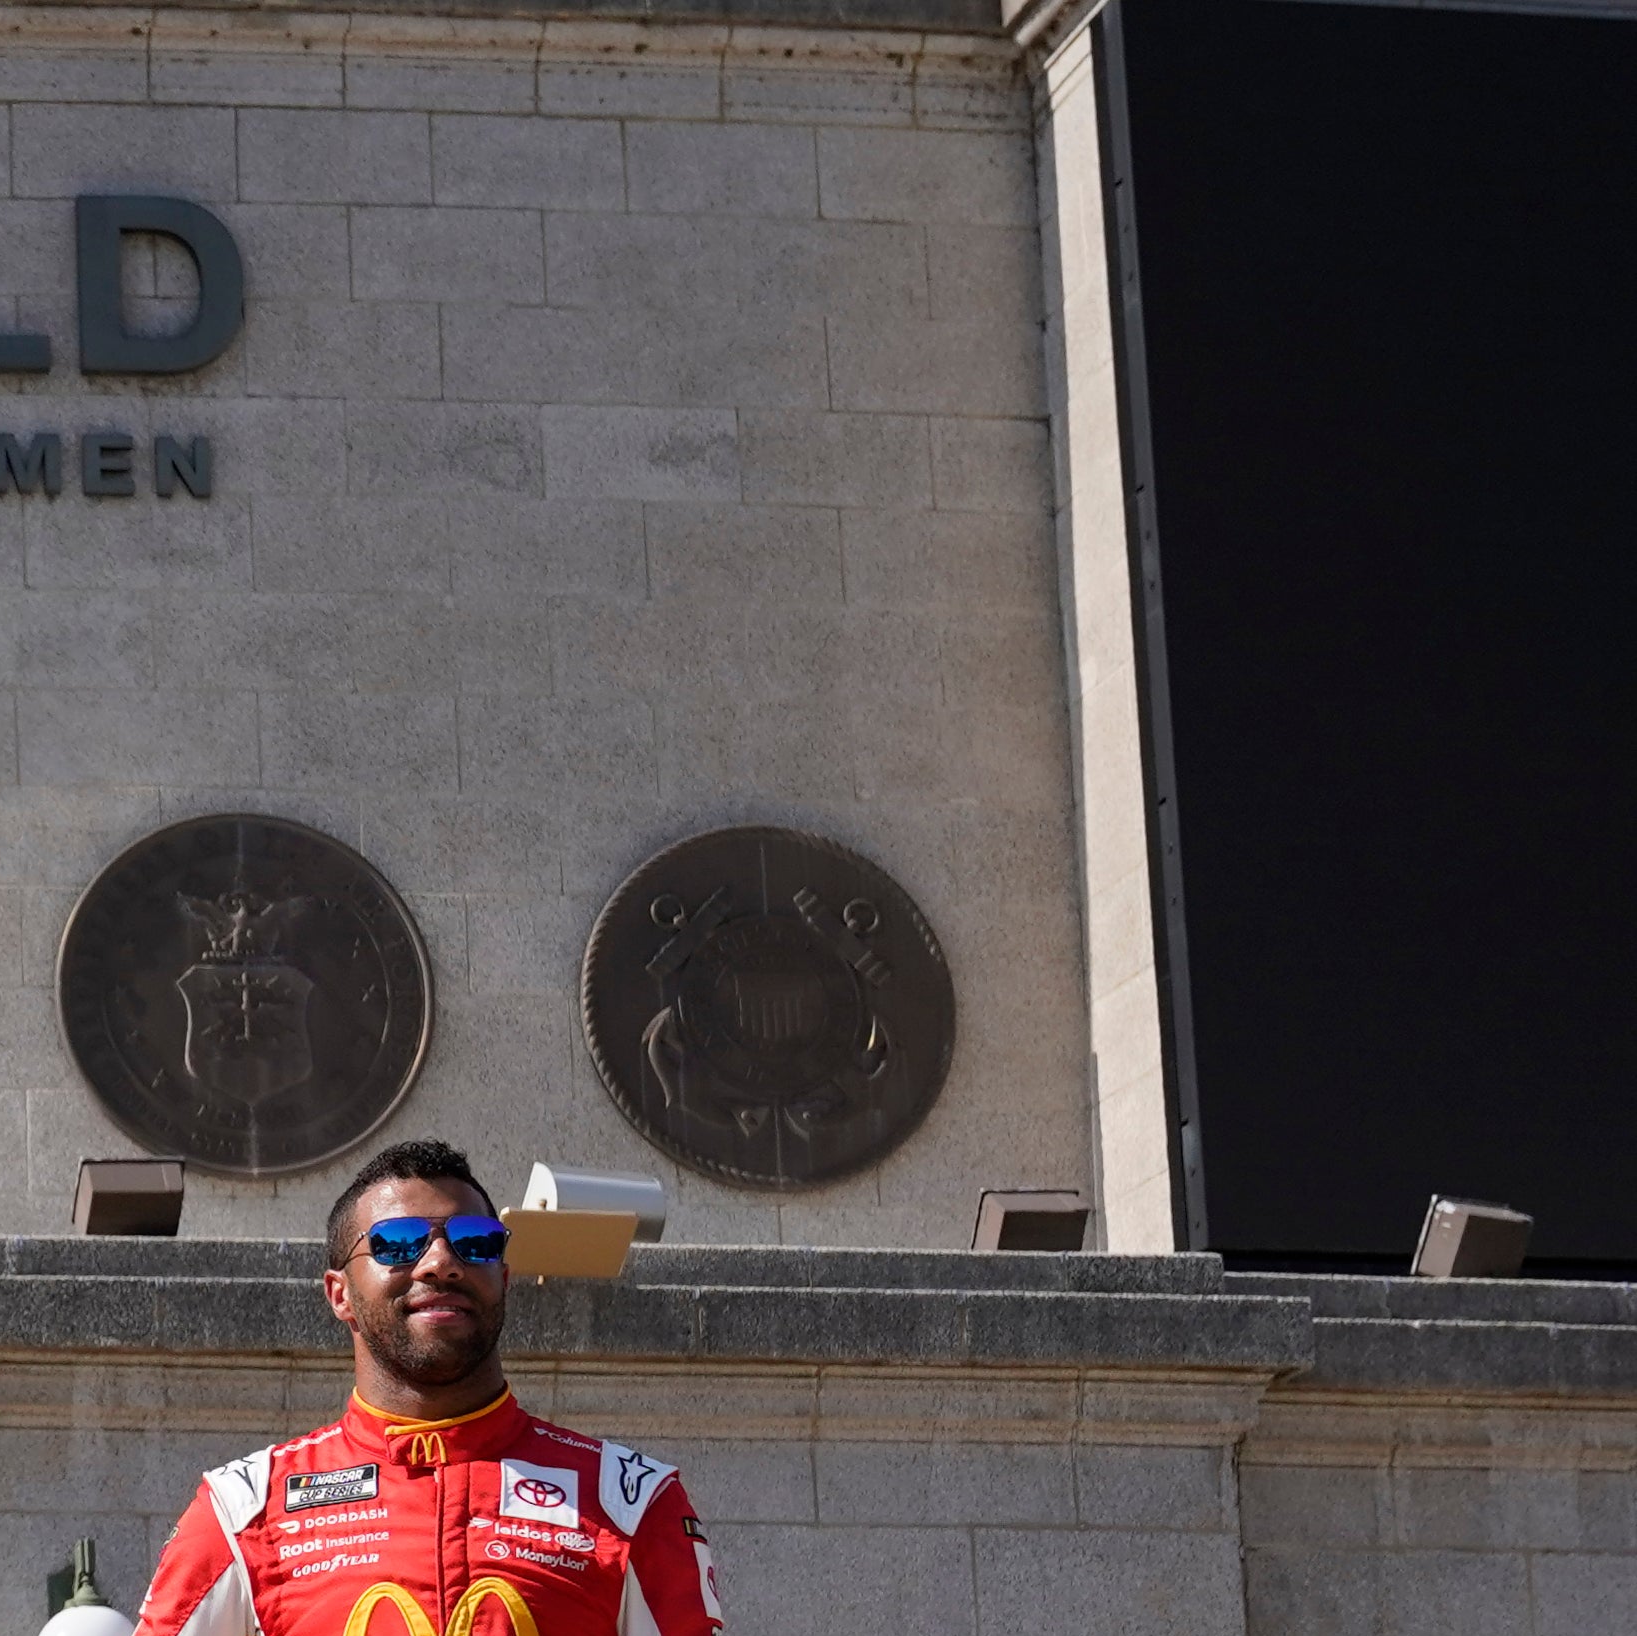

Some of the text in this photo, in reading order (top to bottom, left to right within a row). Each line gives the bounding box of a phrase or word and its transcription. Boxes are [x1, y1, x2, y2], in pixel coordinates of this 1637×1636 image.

[315, 1469, 365, 1486] NASCAR
[299, 1484, 365, 1503] CUP SERIES
[304, 1508, 388, 1529] DOORDASH
[279, 1531, 389, 1560] Root Insurance
[292, 1553, 380, 1578] GOODYEAR
